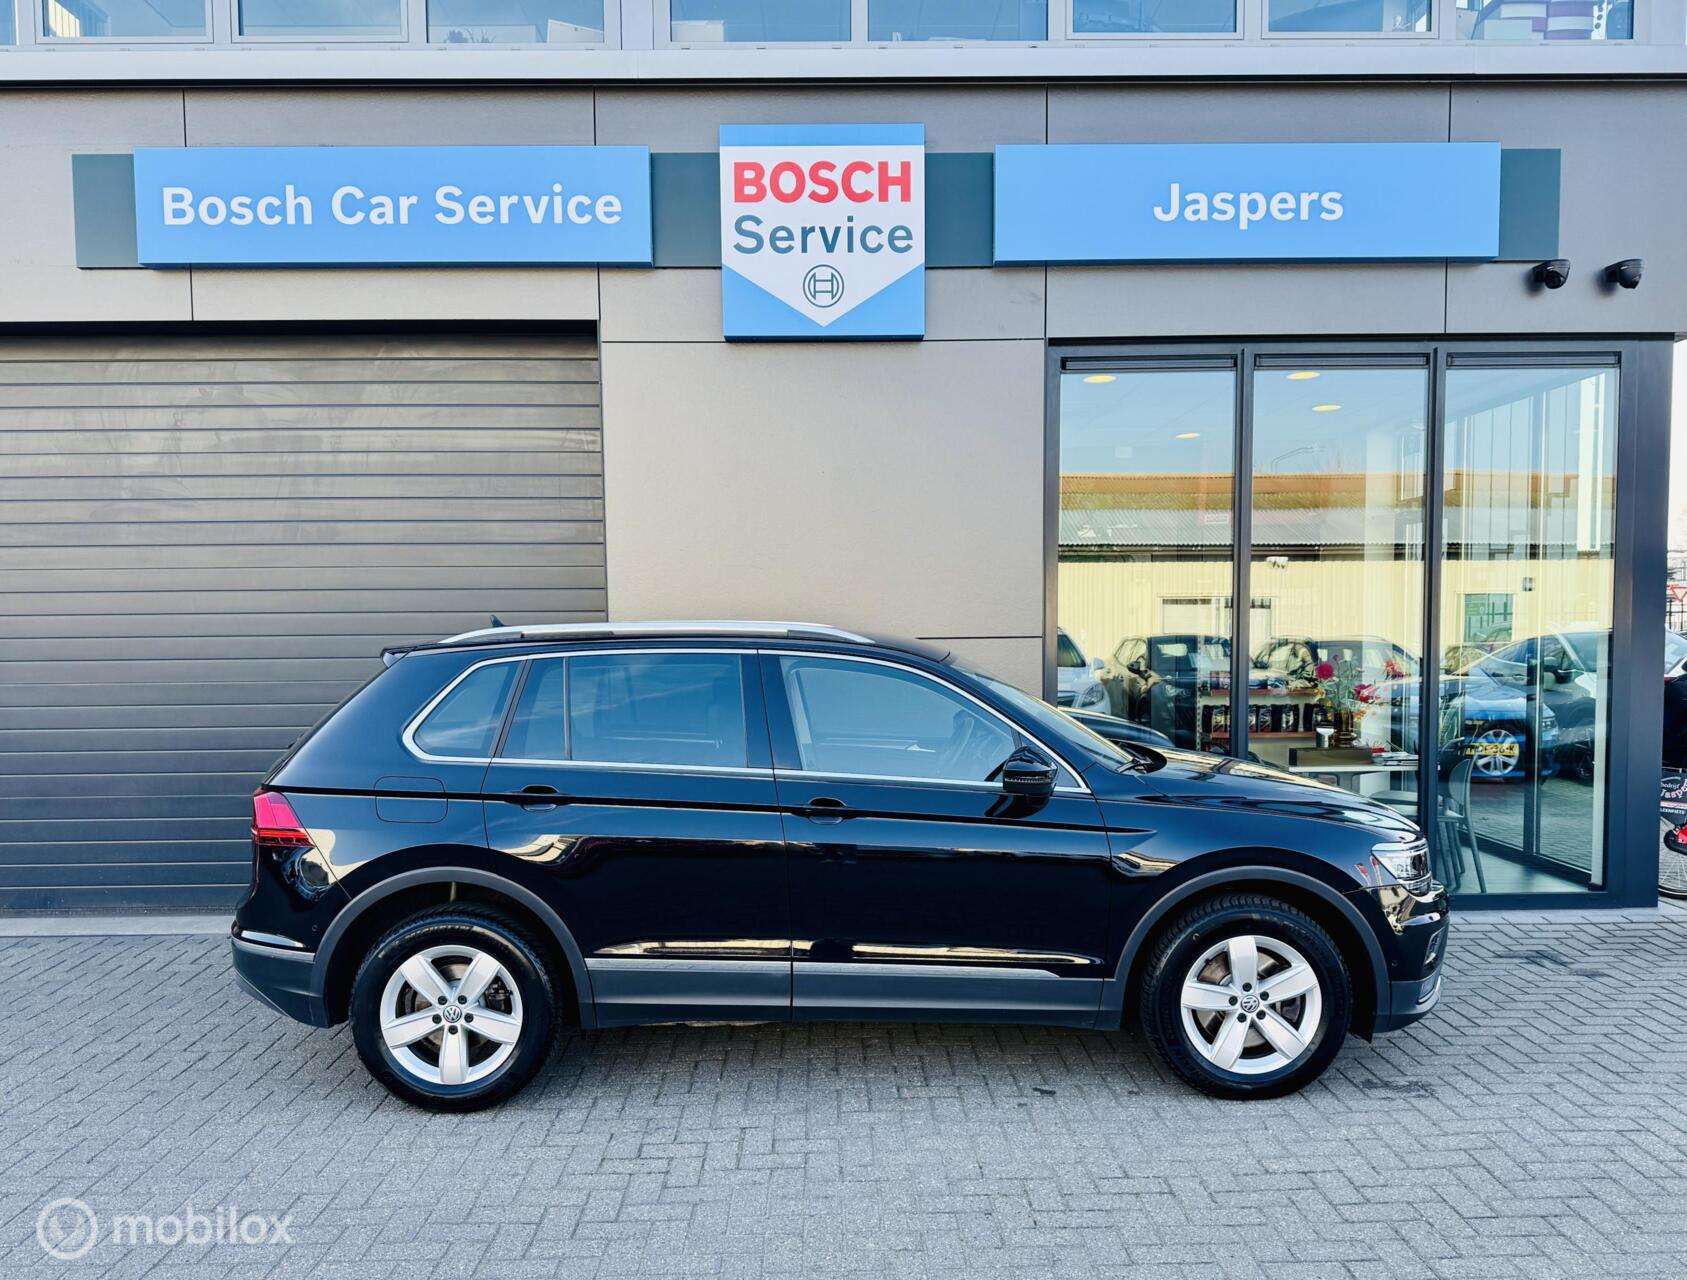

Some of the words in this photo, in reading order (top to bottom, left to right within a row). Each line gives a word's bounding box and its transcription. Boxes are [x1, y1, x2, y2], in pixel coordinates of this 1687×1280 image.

[733, 160, 912, 204] BOSCH
[163, 184, 313, 226] Bosch
[331, 185, 418, 226] Car
[435, 184, 623, 225] Service
[1153, 183, 1344, 231] Jaspers
[733, 214, 914, 255] Service
